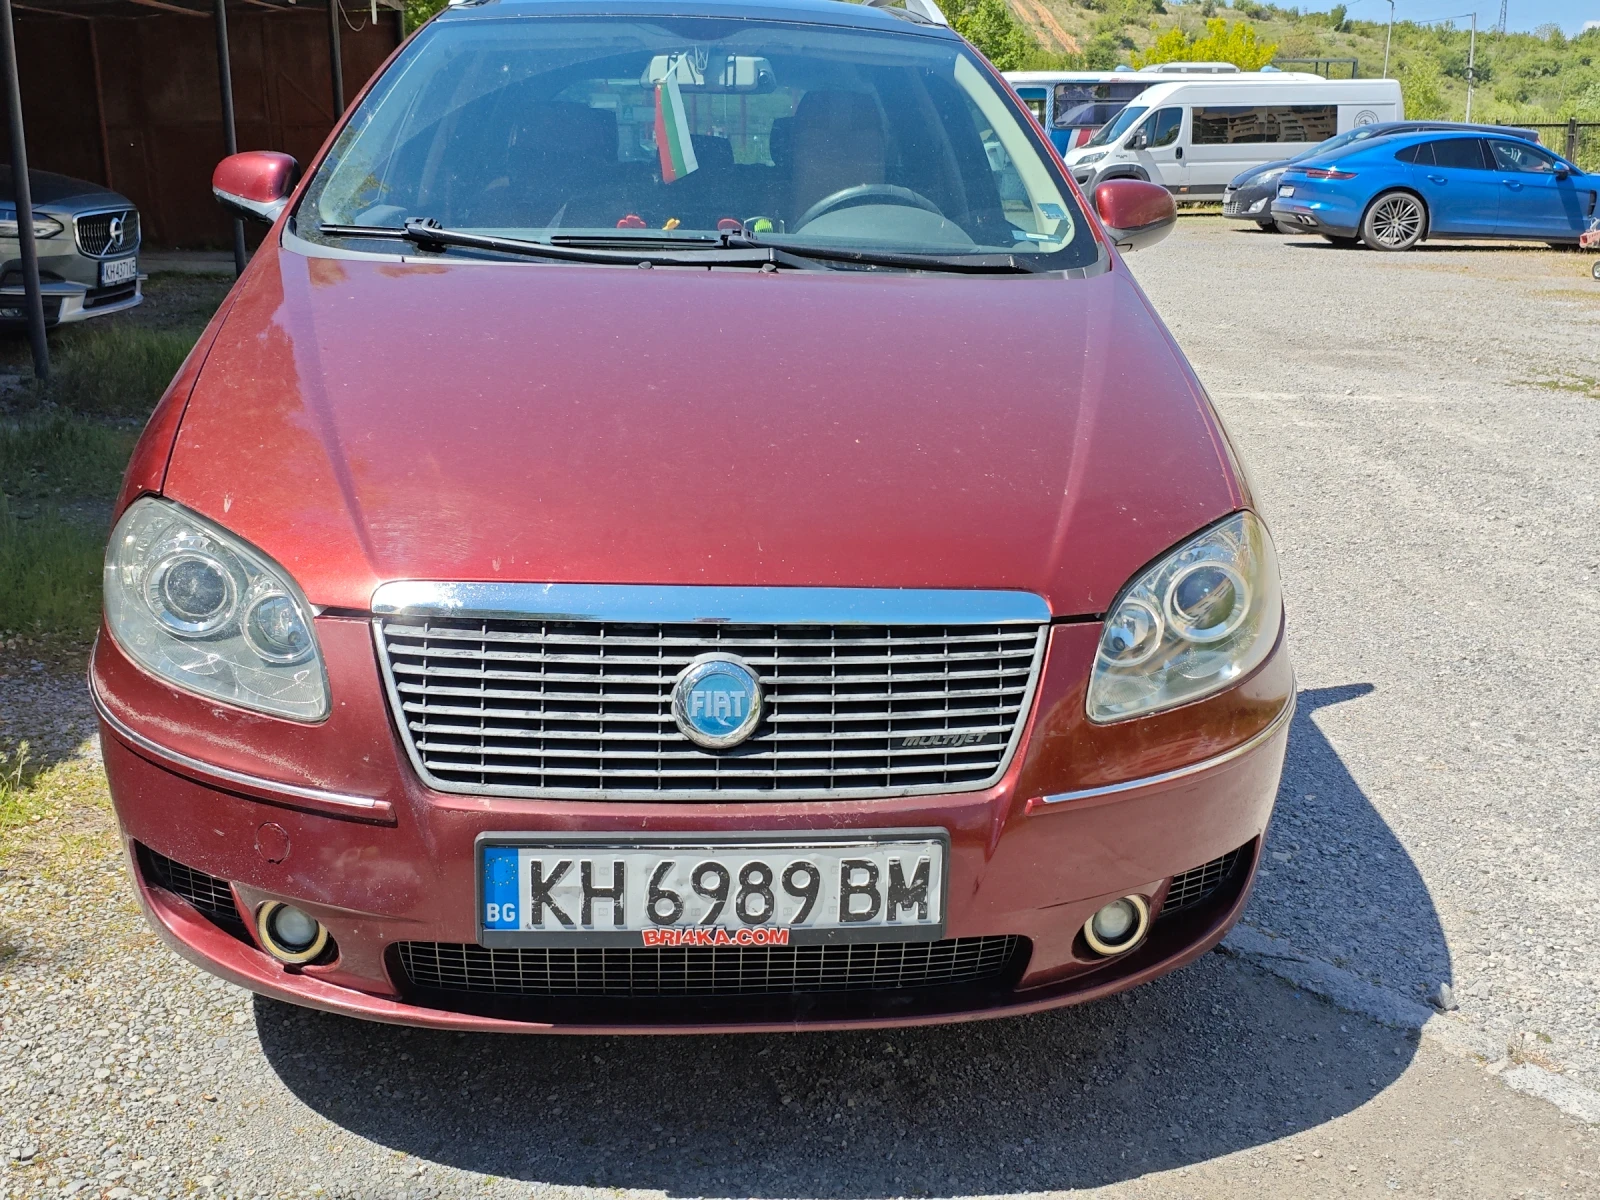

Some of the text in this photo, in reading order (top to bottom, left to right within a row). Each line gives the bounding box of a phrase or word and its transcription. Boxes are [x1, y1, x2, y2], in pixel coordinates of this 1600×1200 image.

[690, 690, 746, 717] FIAT
[901, 732, 988, 747] MULTIJET
[486, 903, 516, 922] BG
[641, 927, 790, 947] BRI4KA.COM
